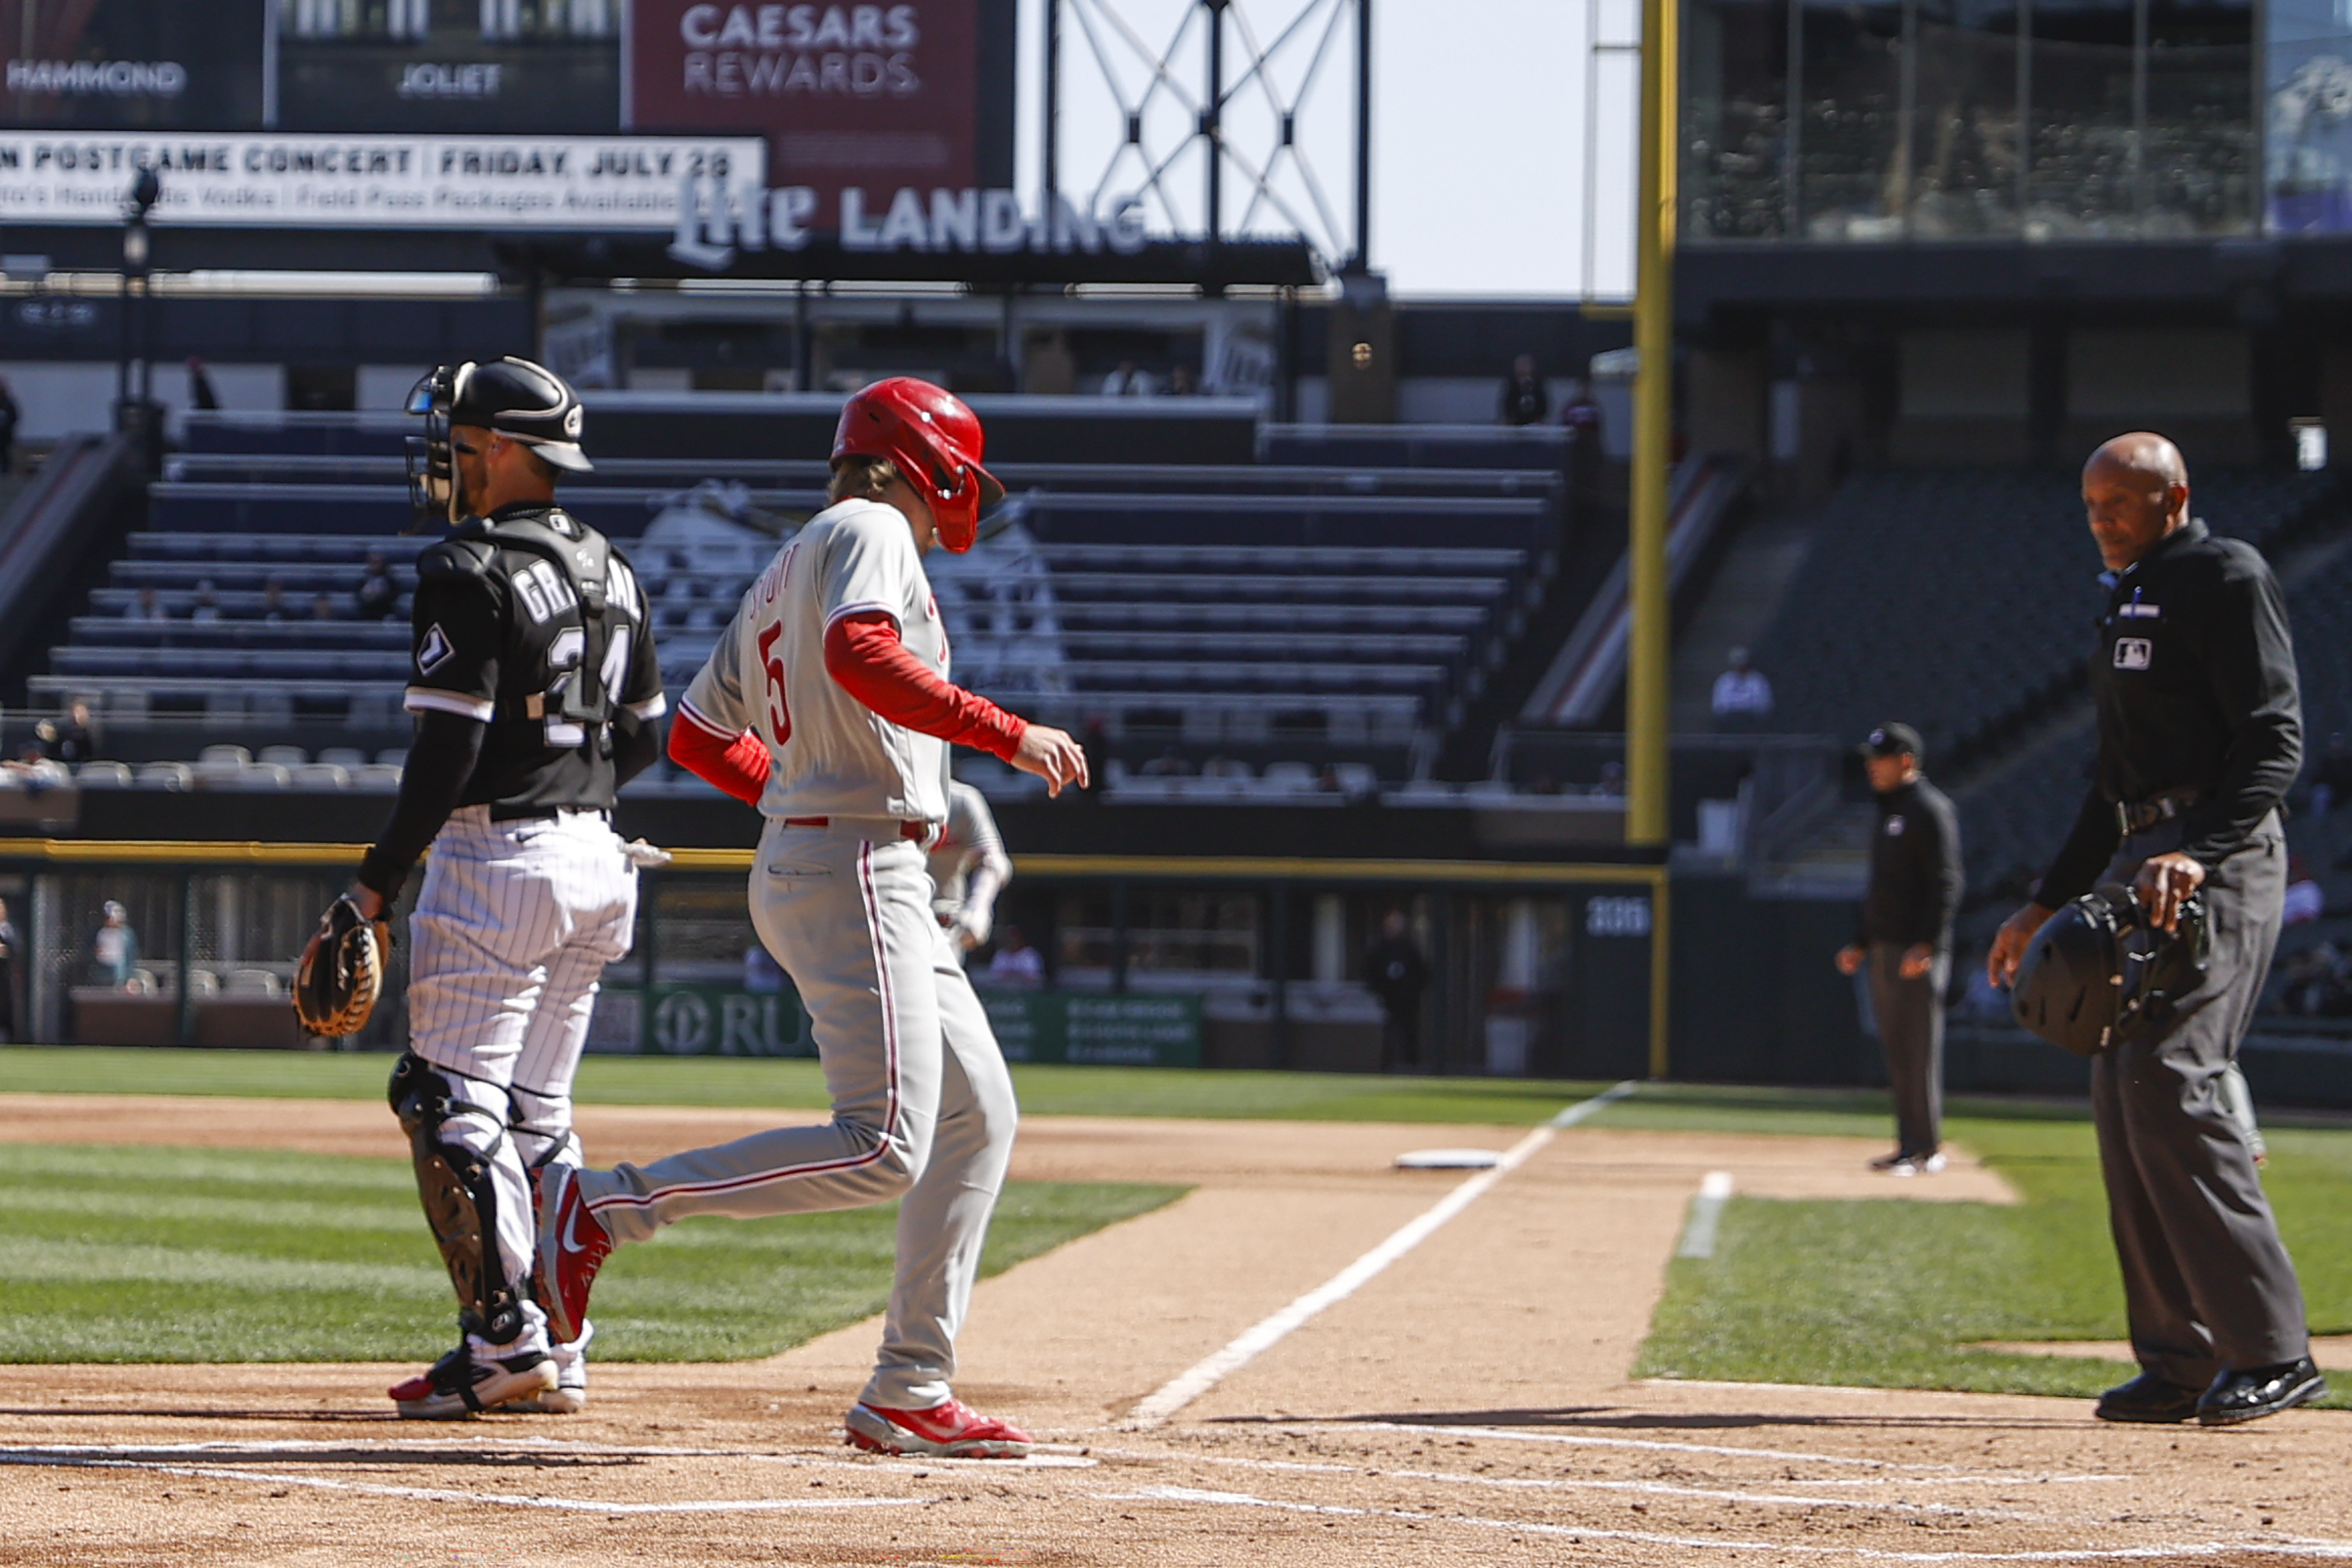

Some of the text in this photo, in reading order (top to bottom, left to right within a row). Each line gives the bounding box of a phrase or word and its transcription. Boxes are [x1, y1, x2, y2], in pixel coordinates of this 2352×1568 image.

[681, 4, 920, 48] CAESARS
[6, 61, 185, 93] HAMMOND
[396, 64, 501, 97] JOLIET
[684, 52, 920, 95] REWARDS
[35, 146, 229, 170] POSTGAME
[245, 147, 411, 172] CONCERT
[588, 151, 674, 175] JULY
[669, 174, 1152, 270] Lite LANDING
[758, 618, 792, 747] 5
